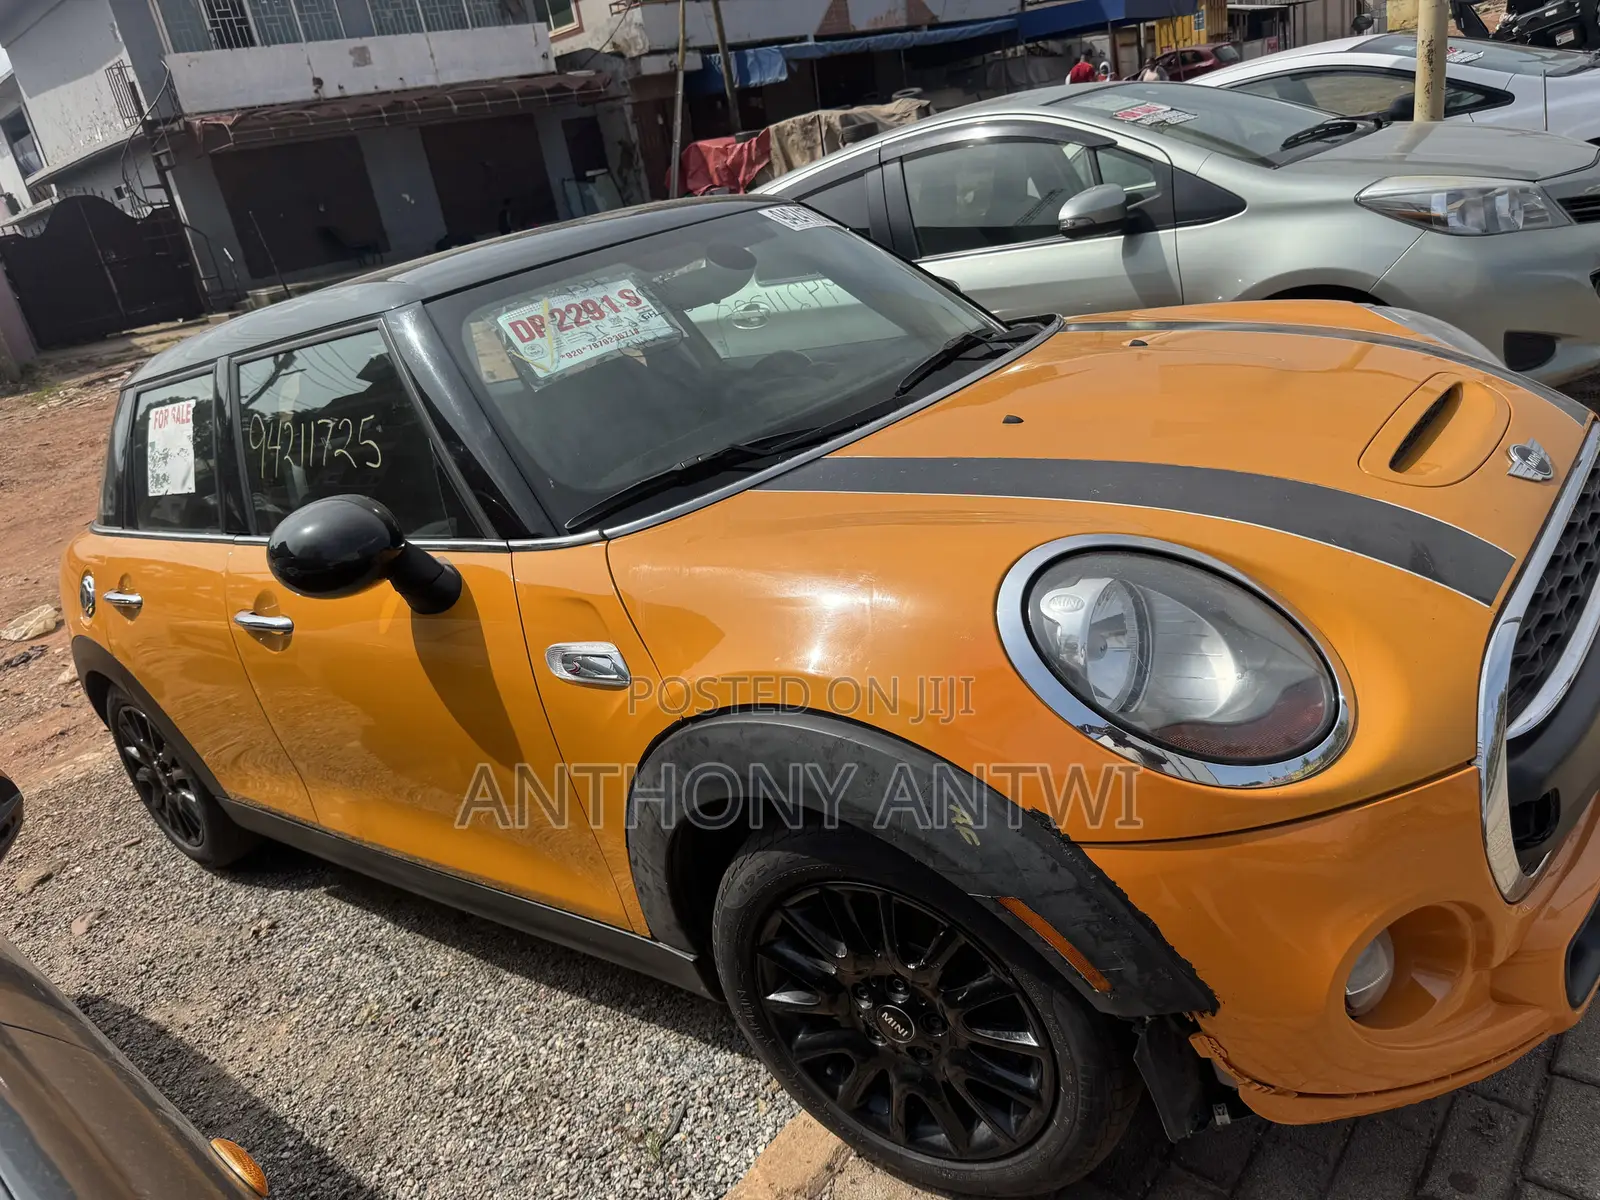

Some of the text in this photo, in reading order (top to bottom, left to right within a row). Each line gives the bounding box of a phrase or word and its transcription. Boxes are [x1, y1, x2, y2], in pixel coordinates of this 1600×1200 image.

[549, 294, 622, 332] 2291
[617, 288, 643, 307] S
[153, 403, 192, 431] FOR SALE
[250, 413, 382, 479] 94211725
[881, 1011, 909, 1037] MINI
